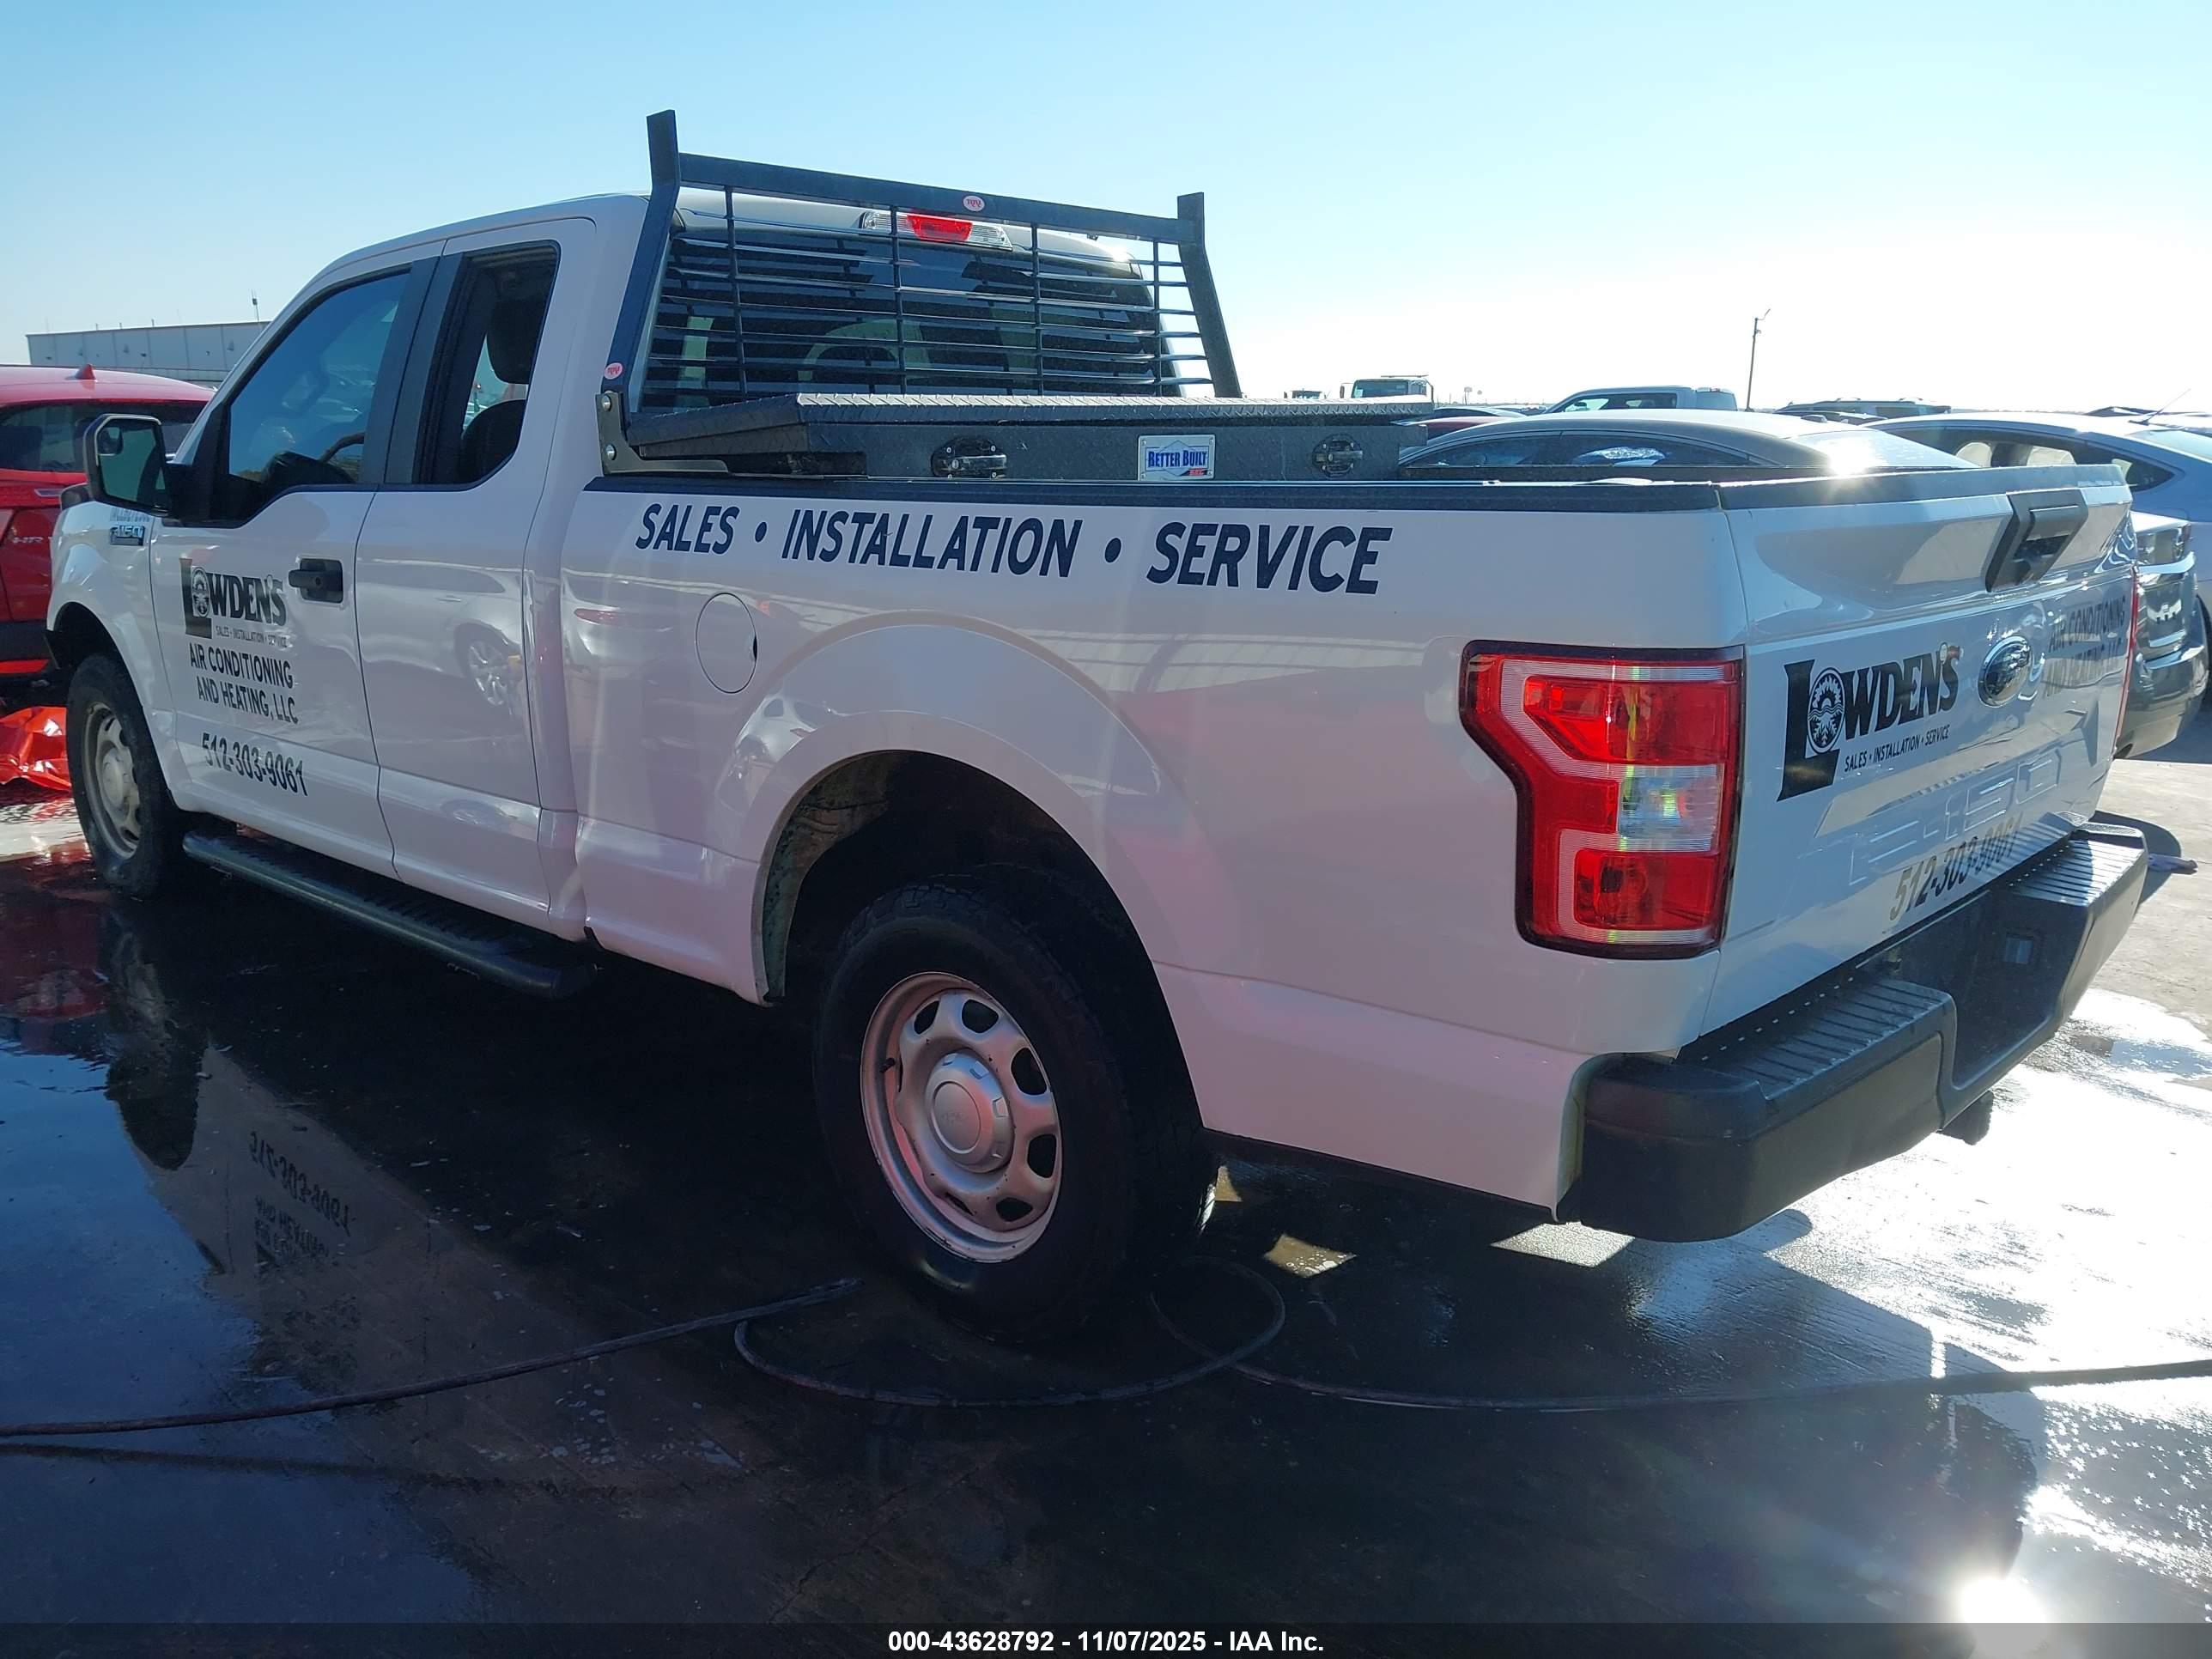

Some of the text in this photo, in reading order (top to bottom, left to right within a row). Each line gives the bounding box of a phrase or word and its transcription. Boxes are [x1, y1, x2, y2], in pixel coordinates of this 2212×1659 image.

[1147, 449, 1207, 468] BETTER BUILT
[635, 503, 1394, 595] SALES INSTALLATION SERVICE
[190, 642, 294, 689] AIR CONDITIONING
[197, 676, 299, 725] AND HEATING, LLC
[202, 732, 308, 797] 512-303-9061
[1844, 724, 1950, 772] SALES INSTALLATION SERVICE
